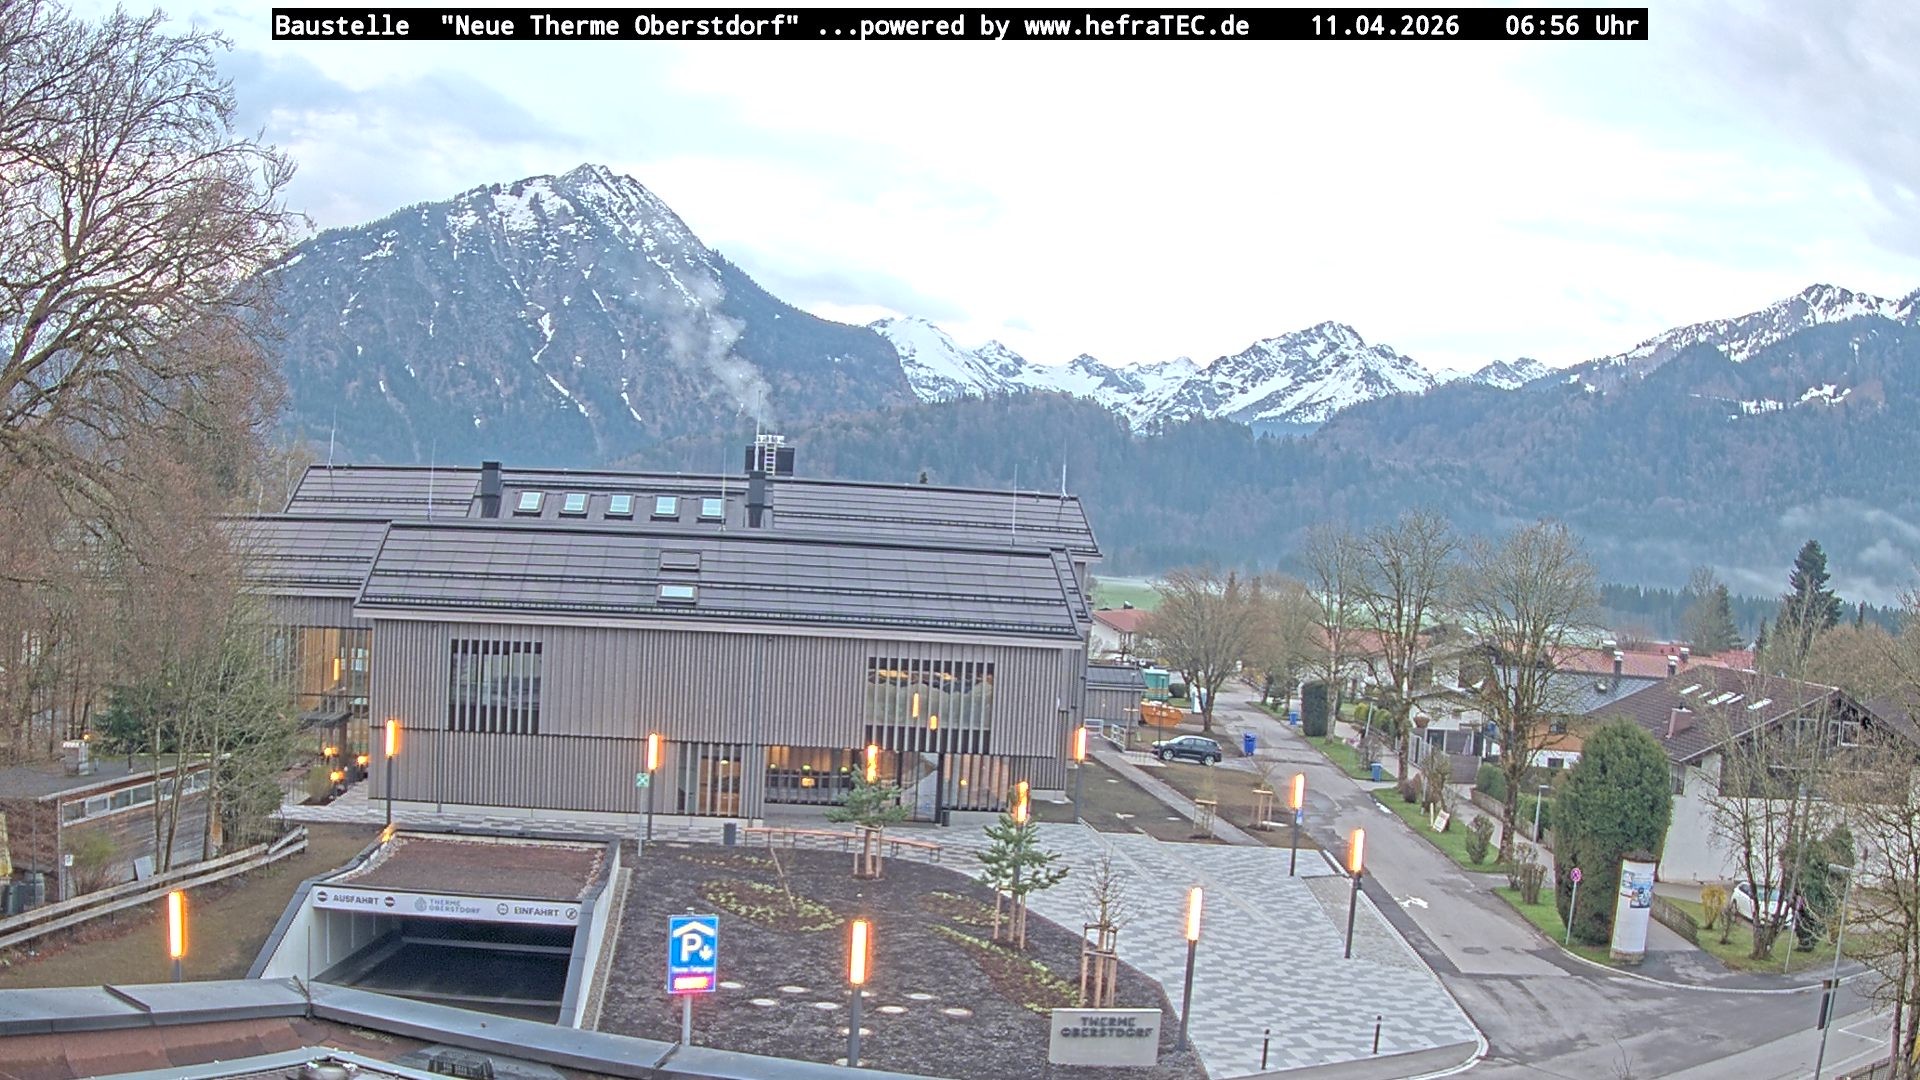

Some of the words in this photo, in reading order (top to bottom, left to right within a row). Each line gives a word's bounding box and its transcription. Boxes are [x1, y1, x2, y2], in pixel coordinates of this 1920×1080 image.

[333, 894, 379, 905] AUSFAHRT
[429, 899, 461, 907] THERME
[428, 905, 481, 914] OBERSTDORF
[514, 906, 560, 917] EINFAHRT
[681, 933, 702, 962] P
[1080, 1016, 1137, 1027] THERME
[1060, 1027, 1155, 1038] OBERSTDORF
